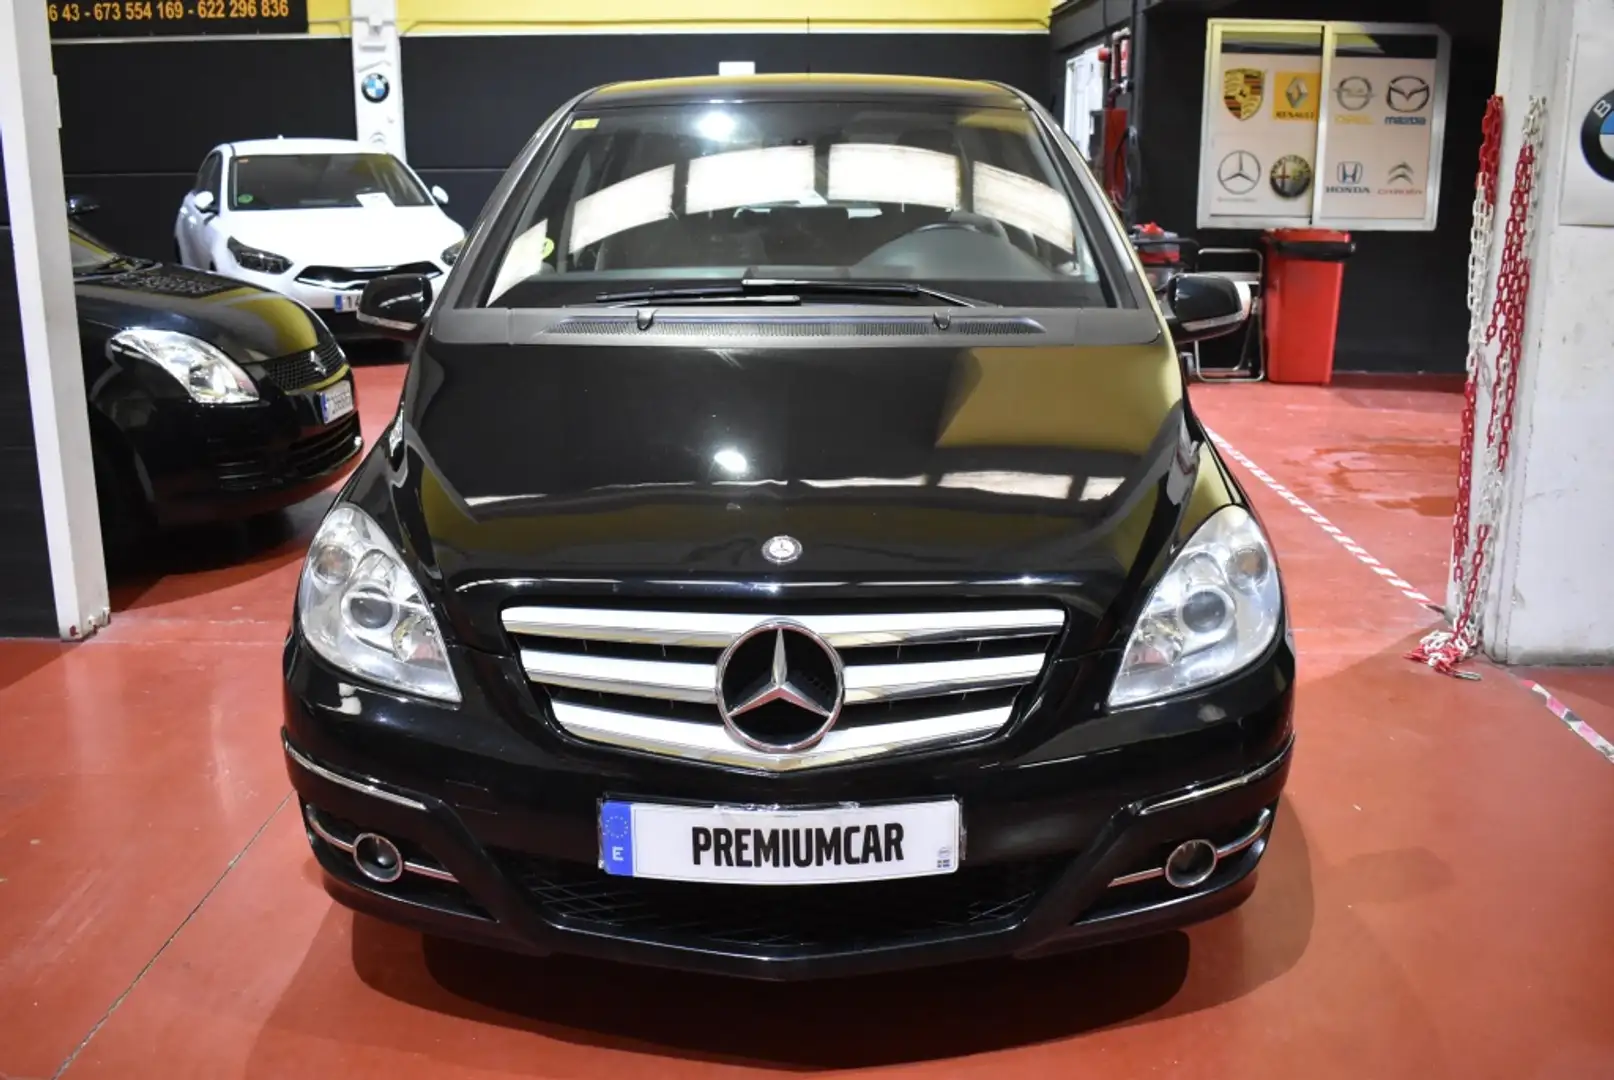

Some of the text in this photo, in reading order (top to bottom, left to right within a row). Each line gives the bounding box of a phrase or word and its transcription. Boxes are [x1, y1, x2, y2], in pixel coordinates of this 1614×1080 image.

[62, 4, 80, 21] 43
[94, 3, 121, 21] 673
[125, 2, 152, 20] 554
[156, 1, 184, 19] 169
[197, 0, 225, 18] 622
[229, 0, 257, 18] 296
[261, 0, 289, 17] 836
[1326, 186, 1370, 194] HONDA
[612, 846, 624, 861] E
[692, 823, 904, 868] PREMIUMCAR
